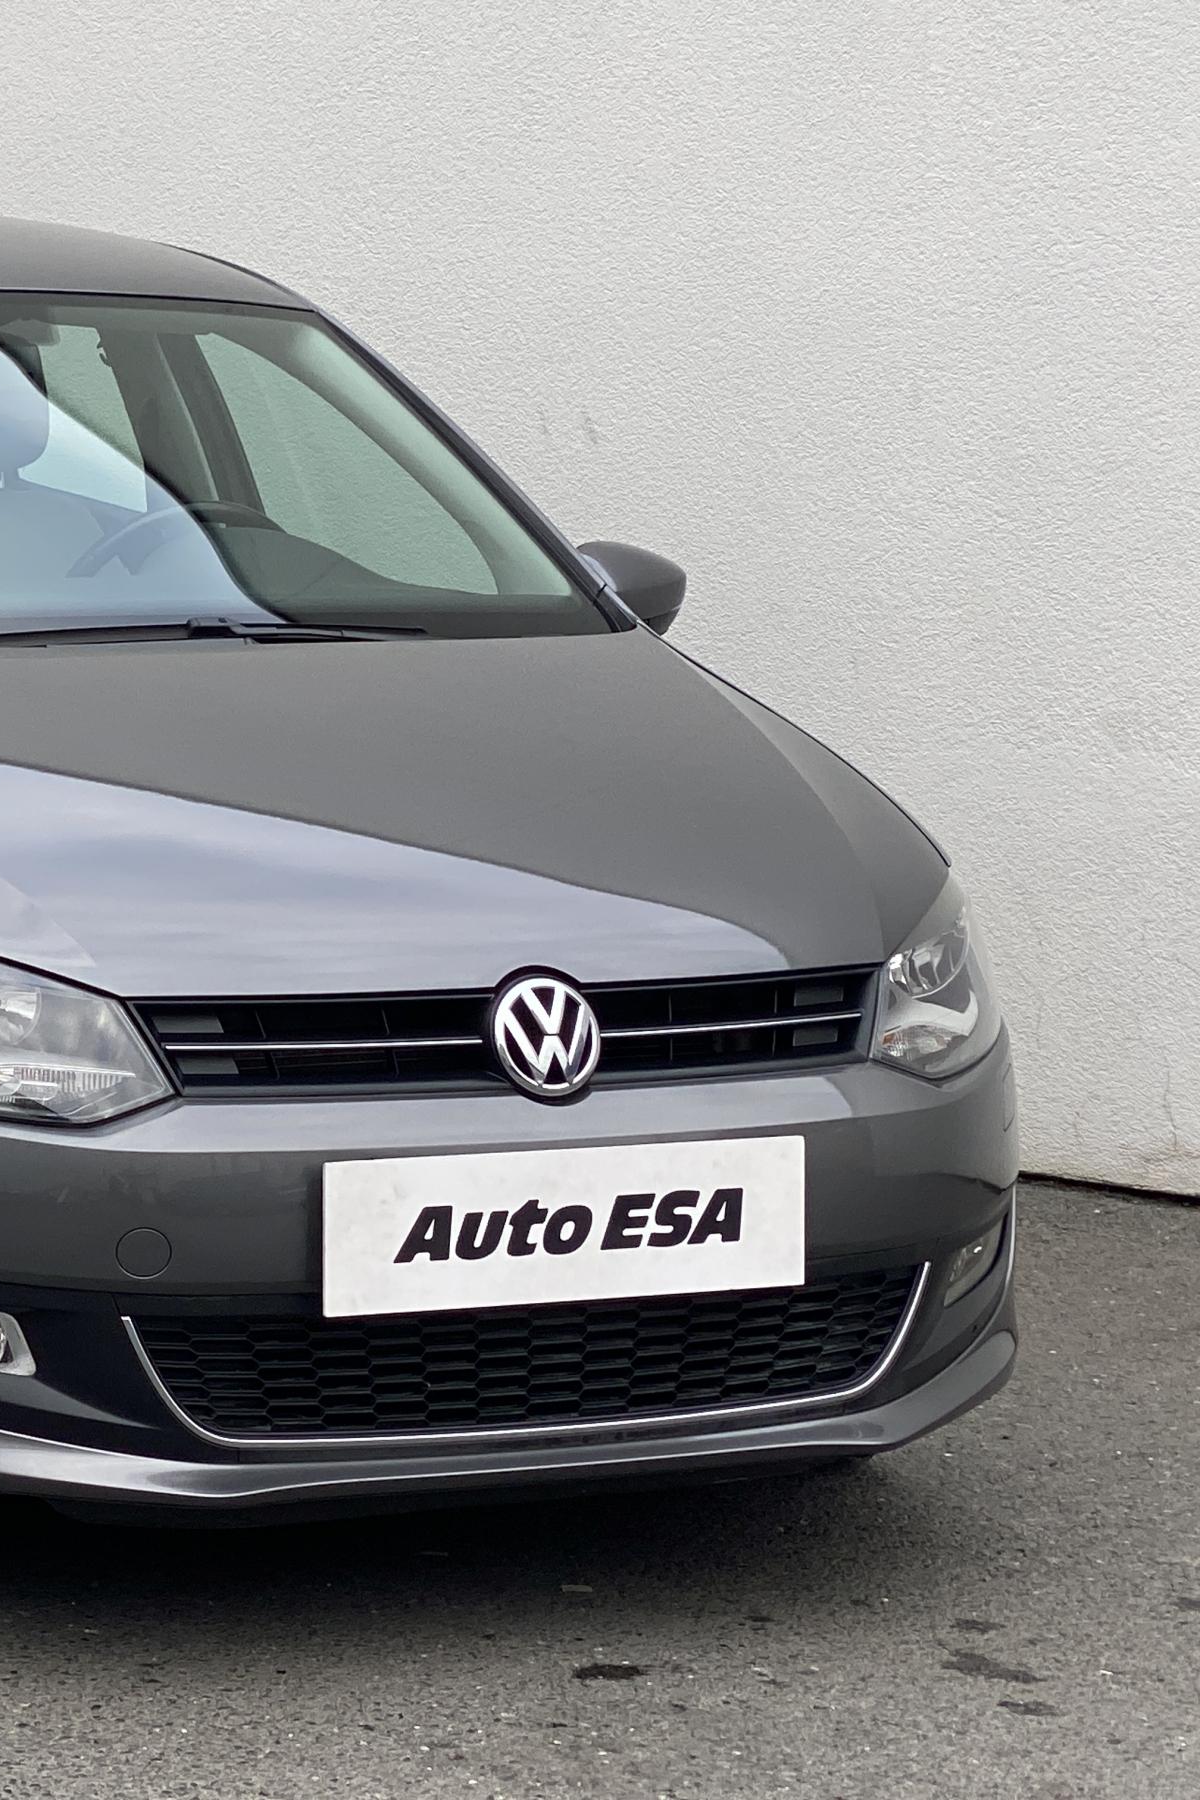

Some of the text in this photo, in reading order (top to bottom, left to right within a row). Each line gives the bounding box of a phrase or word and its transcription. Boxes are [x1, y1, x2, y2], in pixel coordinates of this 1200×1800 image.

[496, 978, 599, 1094] VW
[393, 1187, 744, 1264] Auto ESA
